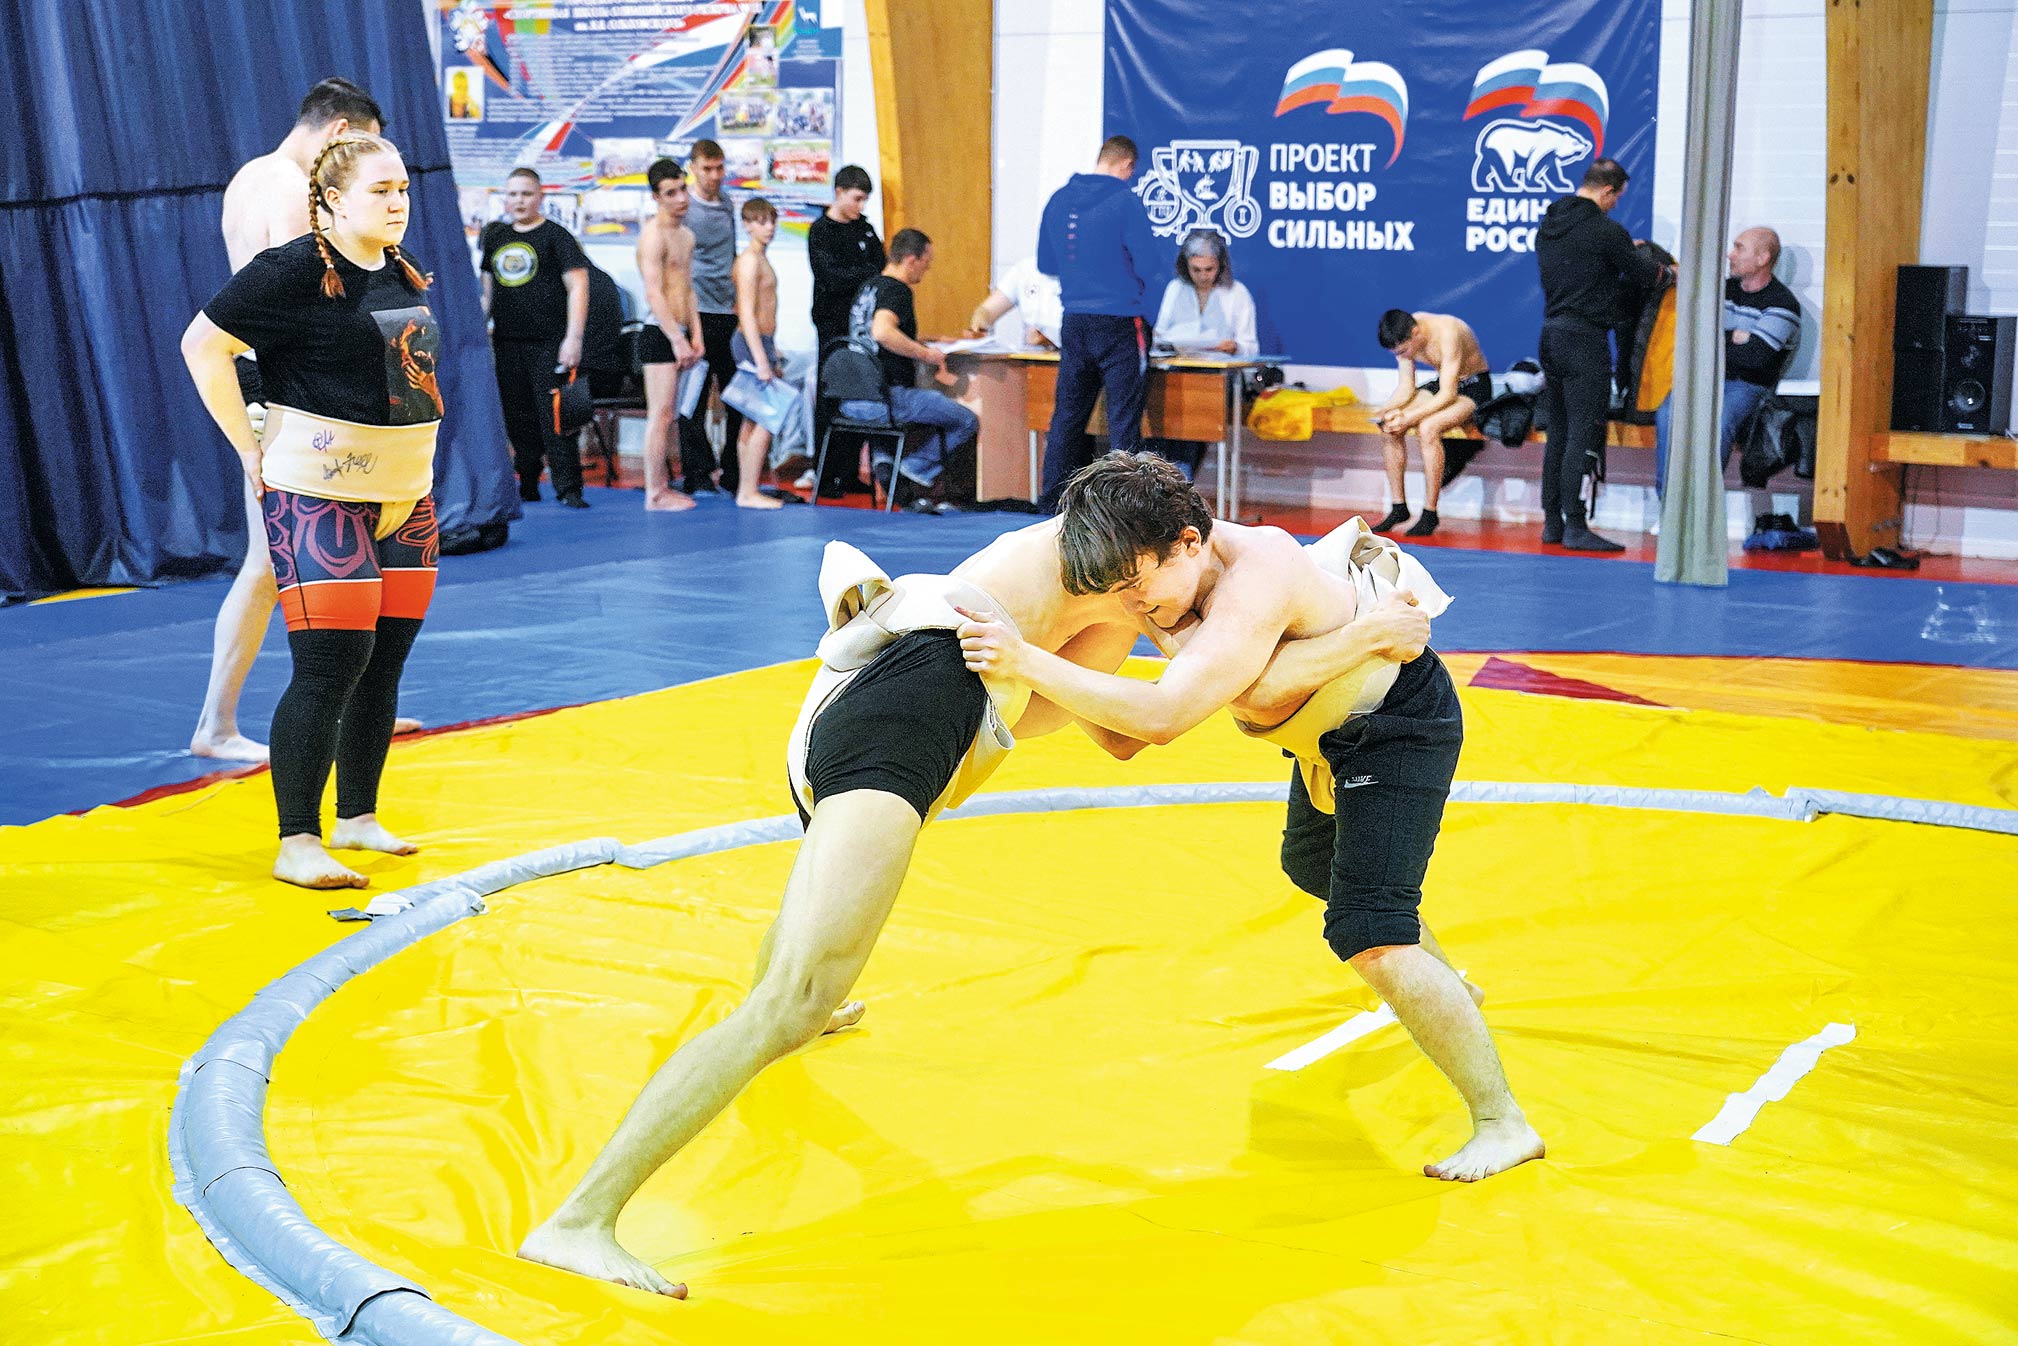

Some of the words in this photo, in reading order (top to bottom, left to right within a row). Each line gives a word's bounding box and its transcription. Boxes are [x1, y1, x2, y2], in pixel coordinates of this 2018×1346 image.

[1269, 143, 1377, 173] ПРОЕКТ
[1269, 181, 1377, 212] ВЫБОР
[1467, 198, 1551, 225] ЕДИН
[1267, 218, 1415, 251] СИЛЬНЫХ
[1466, 226, 1538, 252] РОСС
